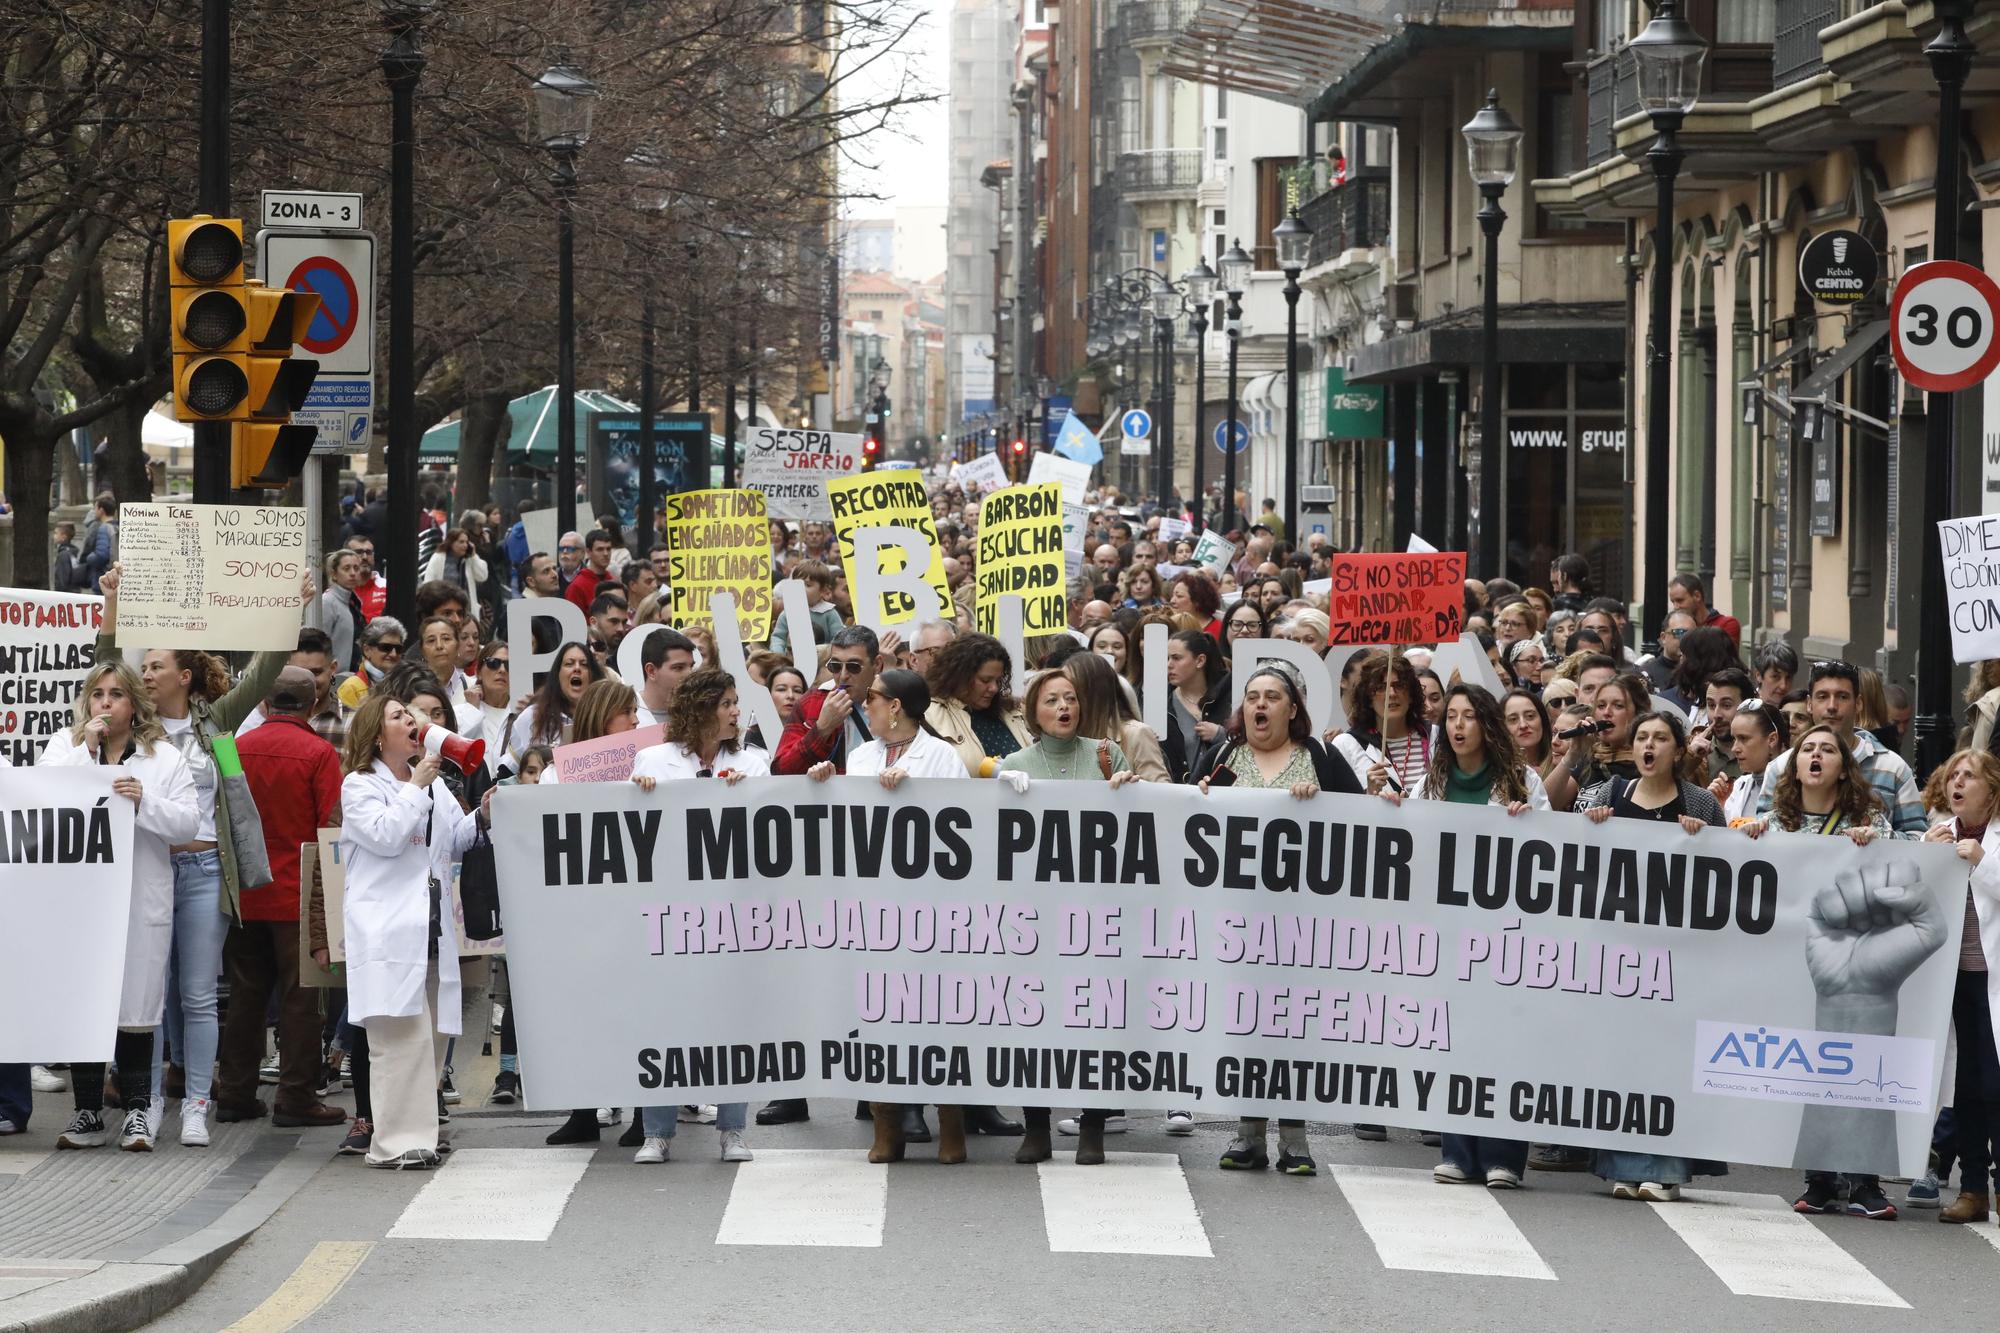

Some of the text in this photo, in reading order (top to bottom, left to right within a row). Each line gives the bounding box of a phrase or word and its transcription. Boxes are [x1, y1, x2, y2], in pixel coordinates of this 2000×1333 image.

[271, 203, 321, 218] ZONA
[340, 206, 351, 221] 3
[1815, 278, 1863, 289] CENTRO
[1826, 267, 1854, 276] Kebab
[1905, 303, 1982, 348] 30
[755, 430, 831, 454] SESPA
[1510, 430, 1568, 447] www.
[166, 505, 193, 519] TCAE
[668, 490, 767, 521] SOMETIDOS
[830, 482, 928, 519] RECORTAD
[985, 485, 1058, 528] BARBÓN
[214, 509, 307, 527] NO SOMOS
[215, 530, 303, 547] MARQUESES
[669, 521, 768, 551] ENGAÑADOS
[980, 525, 1063, 566] ESCUCHA
[222, 560, 299, 580] SOMOS
[671, 552, 771, 581] SILENCIADOS
[978, 562, 1059, 599] SANIDAD
[1366, 565, 1391, 589] NO
[1395, 558, 1460, 588] SABES
[206, 592, 301, 608] TRABAJADORES
[1394, 617, 1423, 642] HAS
[562, 743, 638, 775] NUESTROS
[542, 809, 664, 887] HAY
[686, 803, 974, 881] MOTIVOS
[996, 807, 1161, 885] PARA
[1183, 812, 1414, 903] SEGUIR
[1436, 831, 1779, 936] LUCHANDO
[641, 900, 1675, 1002] TRABAJADORXS DE LA SANIDAD PÚBLICA
[859, 970, 1453, 1053] UNIDXS EN SU DEFENSA
[1709, 1027, 1854, 1076] ATAS
[637, 1029, 1676, 1137] SANIDAD PÚBLICA UNIVERSAL, GRATUITA Y DE CALIDAD
